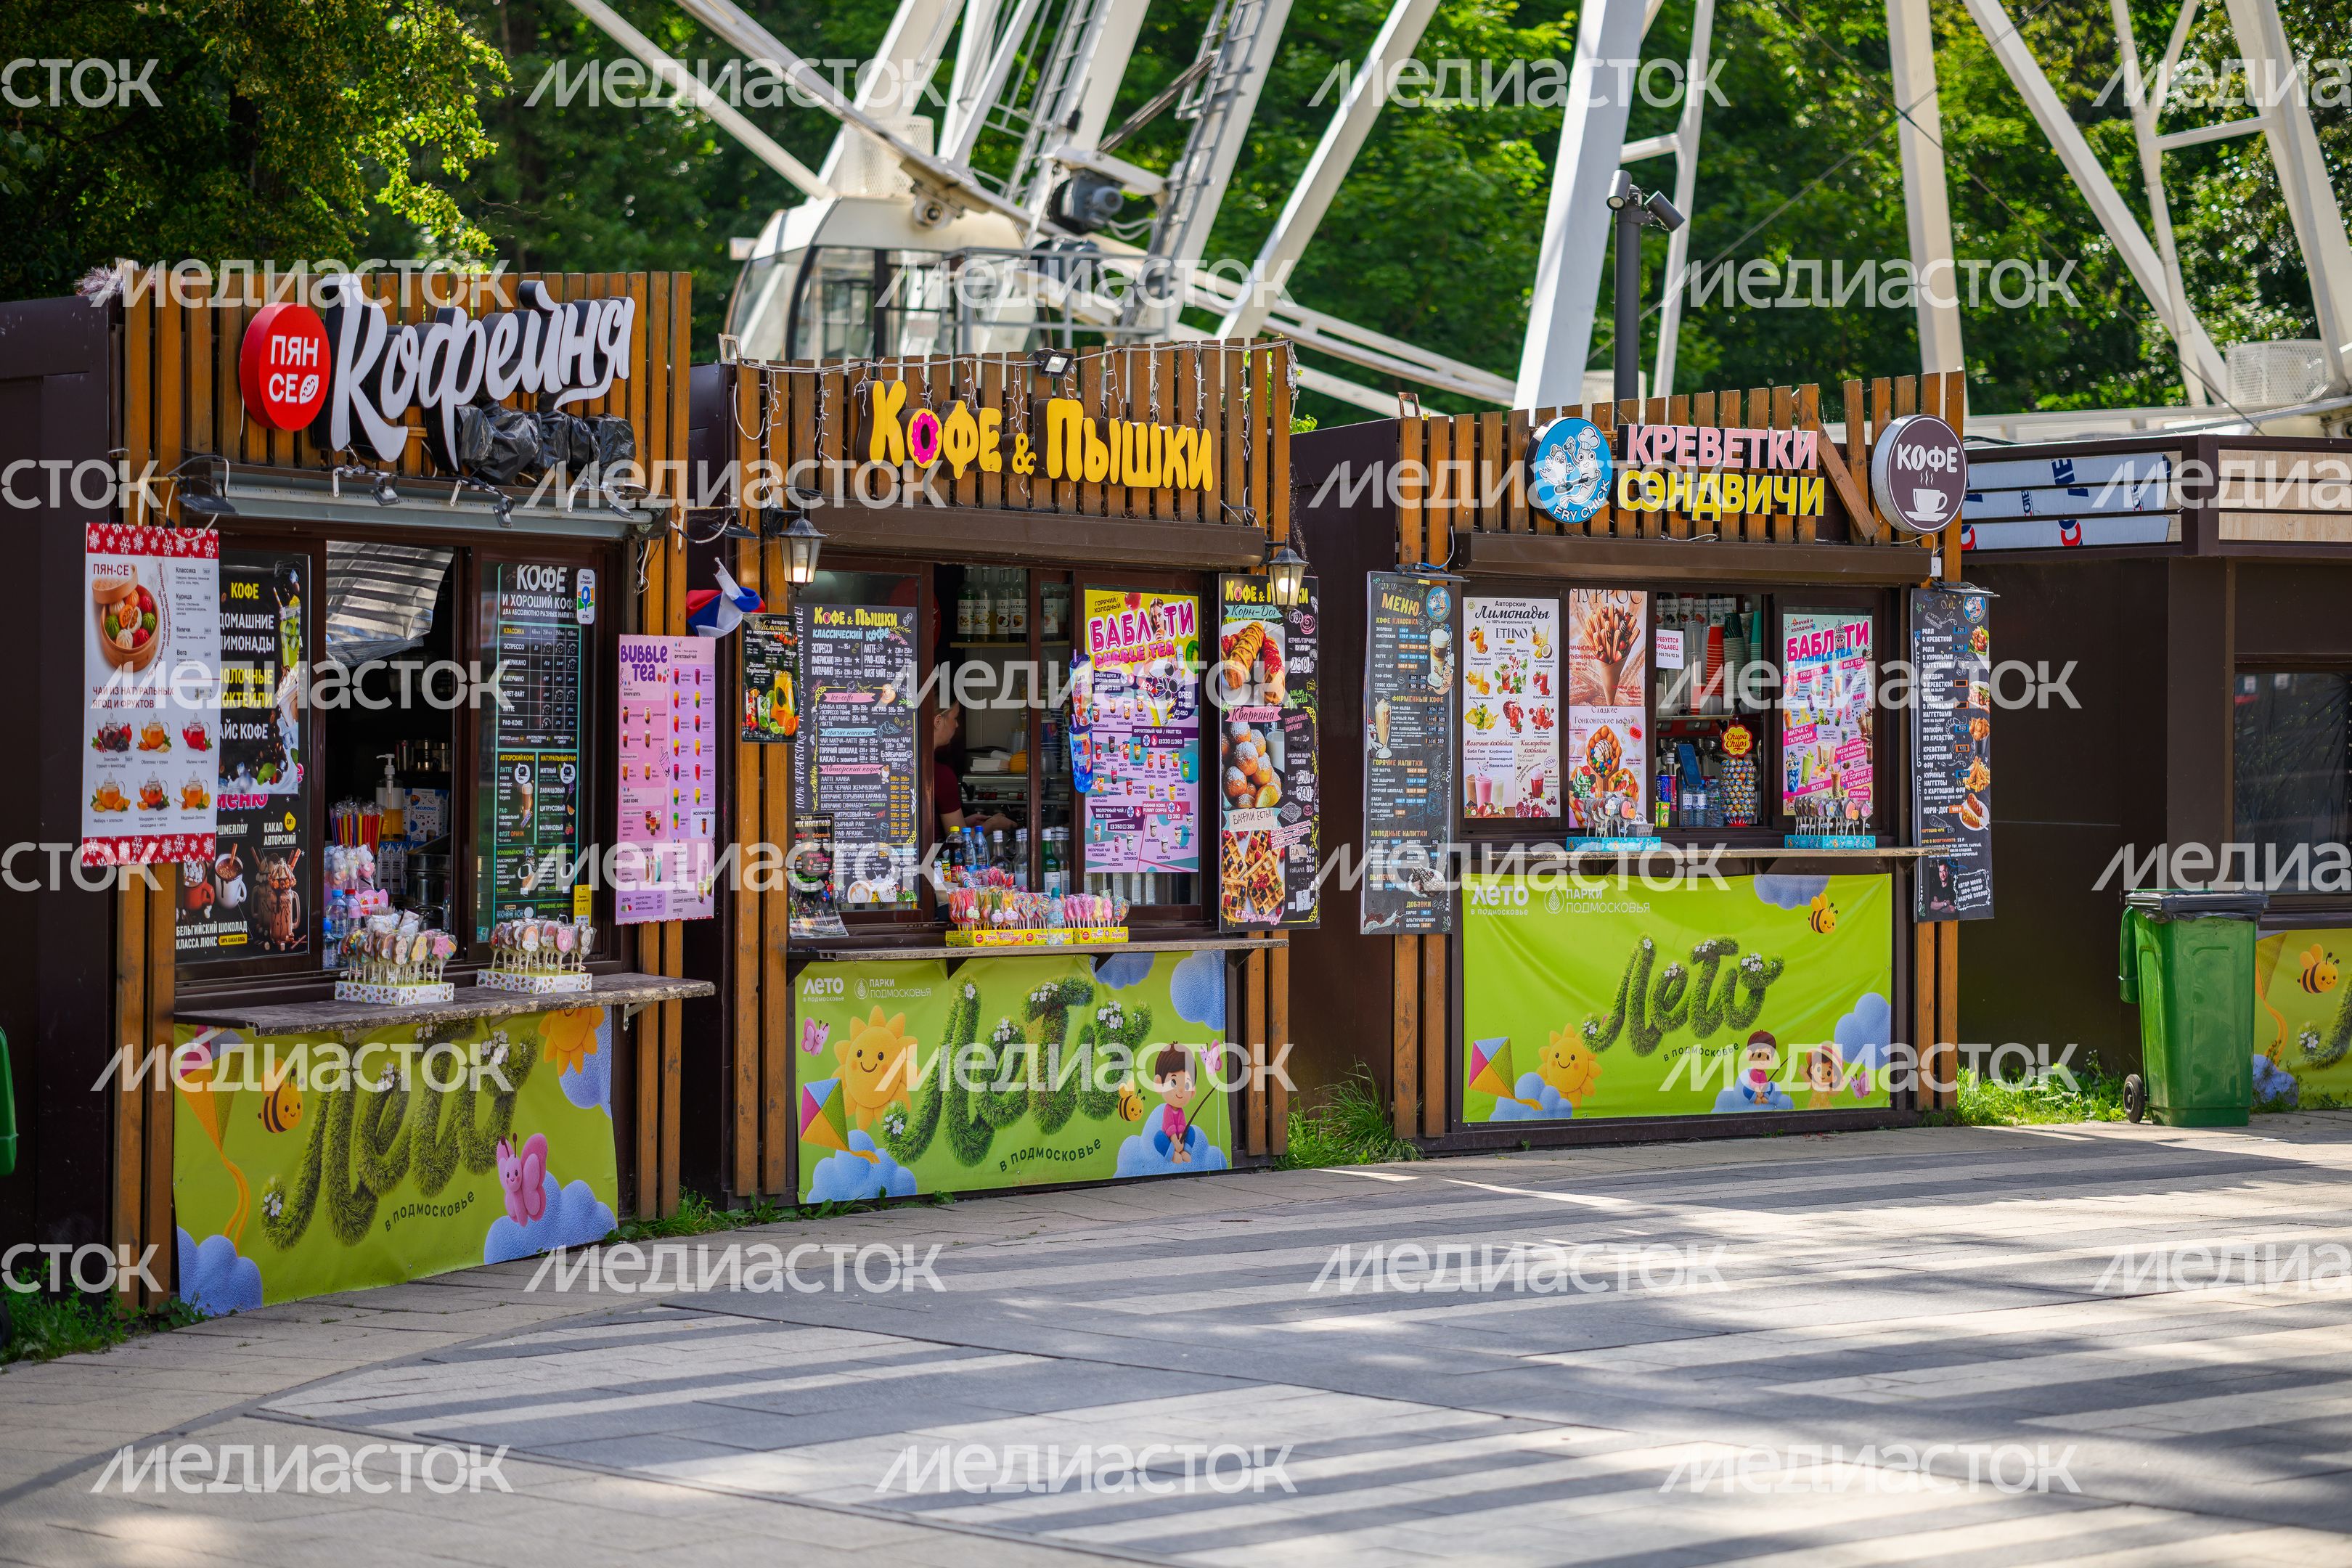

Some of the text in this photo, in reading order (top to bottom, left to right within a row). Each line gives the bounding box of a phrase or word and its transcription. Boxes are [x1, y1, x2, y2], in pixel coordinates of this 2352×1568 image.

[269, 335, 319, 367] ПЯН
[321, 274, 637, 472] Кофейня
[269, 372, 299, 404] СЕ
[1012, 433, 1037, 475] &
[1628, 425, 1818, 470] КРЕВЕТКИ
[1896, 442, 1958, 474] КОФЕ
[1553, 479, 1610, 523] FRY CHICK
[1618, 470, 1824, 521] СЭНДВИЧИ
[93, 564, 129, 576] ПЯН-СЕ
[517, 565, 567, 593] КОФЕ
[231, 582, 259, 599] КОФЕ
[502, 595, 508, 605] И
[510, 595, 553, 608] ХОРОШИЙ
[1094, 603, 1121, 613] ХОЛОДНЫЙ
[1381, 592, 1419, 617] МЕНЮ
[1475, 605, 1550, 620] Лимонады
[847, 616, 853, 625] &
[813, 628, 862, 640] КЛАССИЧЕСКИЙ
[1090, 611, 1151, 652] БАБЛ
[1495, 628, 1527, 639] ETHNO
[812, 643, 833, 654] ЭСПРЕССО
[1787, 629, 1834, 661] БАБЛ
[1094, 640, 1175, 669] BUBBLE TEA
[1835, 646, 1853, 658] TEA
[812, 656, 834, 665] АМЕРИКАНО
[221, 668, 273, 685] ОЛОЧНЫЕ
[812, 666, 833, 676] КАПУЧИНО
[93, 686, 174, 696] ЧАЙ ИЗ НАТУРАЛЬНЫХ
[221, 687, 272, 708] ОКТЕЙЛИ
[1178, 691, 1192, 700] OREO
[93, 700, 113, 709] ЯГОД
[121, 699, 155, 709] ФРУКТОВ
[1232, 709, 1275, 721] Кваркини
[1575, 716, 1634, 726] Гонконгские вафли
[240, 724, 269, 739] КОФЕ
[1726, 740, 1747, 751] Chups
[1233, 811, 1255, 825] ВАФЛИ
[264, 822, 283, 833] КАКАО
[264, 832, 296, 846] АВТОРСКИЙ
[1567, 889, 1602, 900] ПАРКИ
[1567, 901, 1650, 913] ПОДМОСКОВЬЯ
[176, 920, 248, 936] БЕЛЬГИЙСКИЙ ШОКОЛАД
[176, 936, 218, 950] КЛАССА ЛЮКС
[870, 979, 895, 988] ПАРКИ
[871, 987, 931, 999] ПОДМОСКОВЬЯ
[1581, 933, 1786, 1058] Лето
[1663, 1053, 1670, 1063] в
[1000, 1159, 1007, 1172] в
[385, 1220, 391, 1233] в
